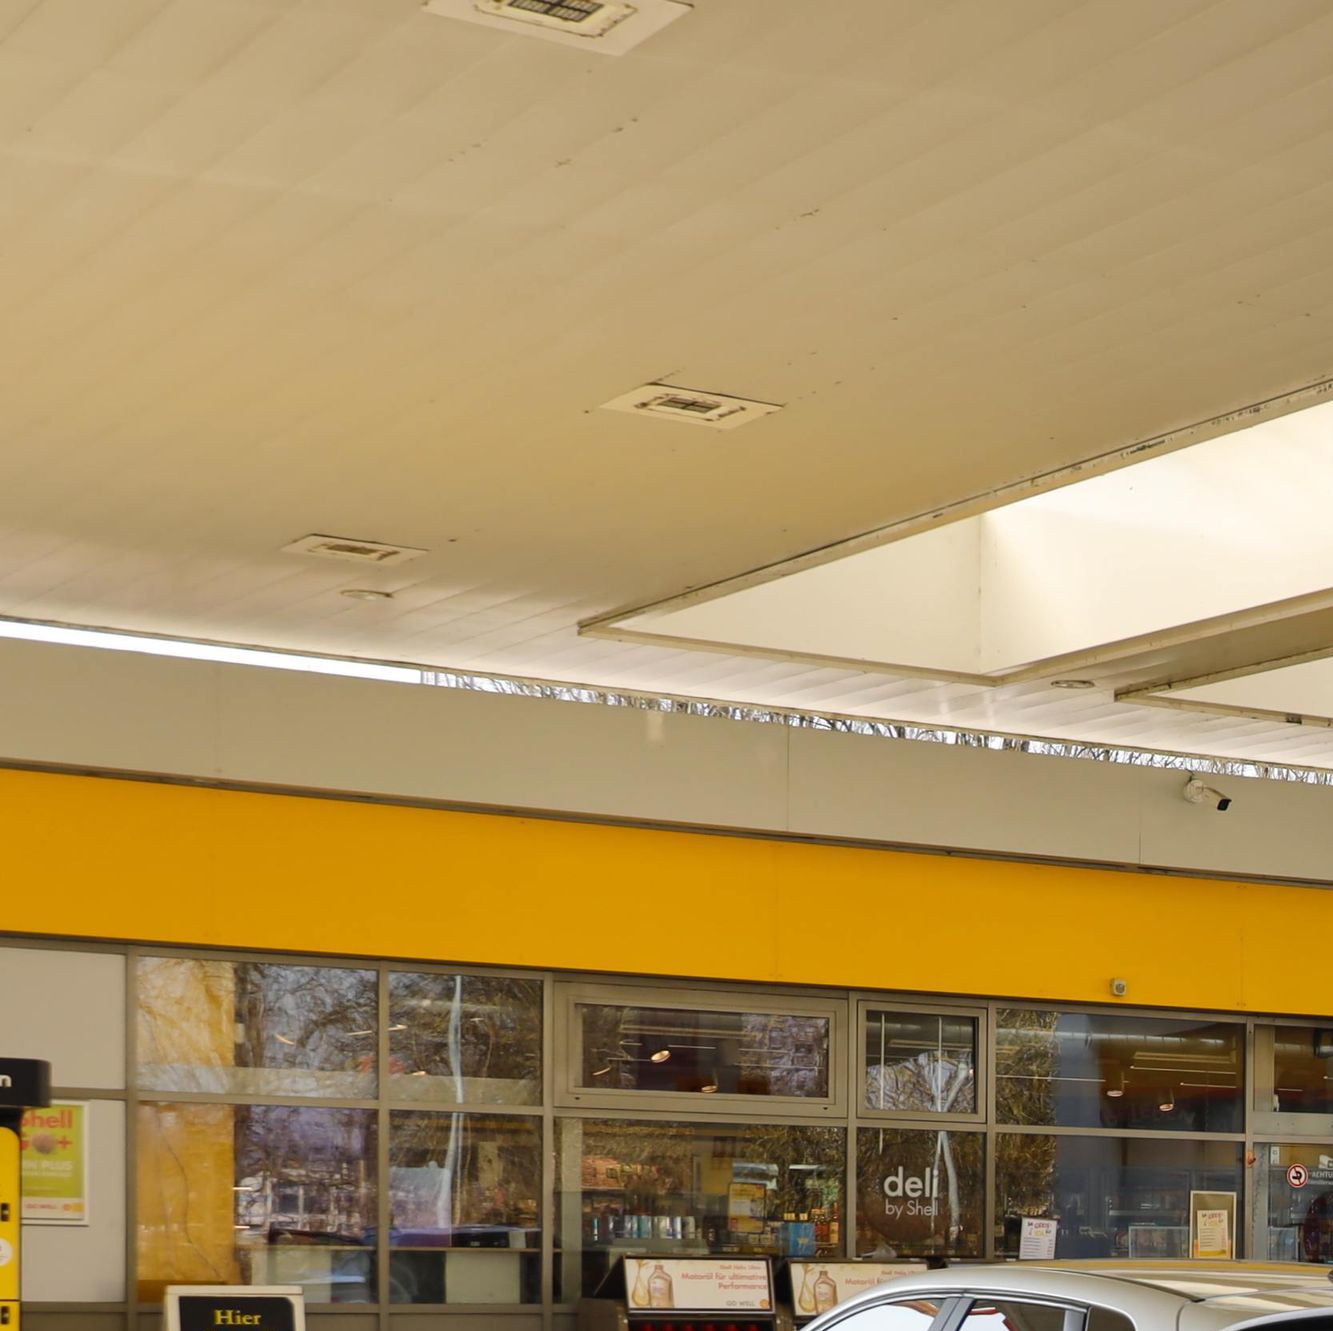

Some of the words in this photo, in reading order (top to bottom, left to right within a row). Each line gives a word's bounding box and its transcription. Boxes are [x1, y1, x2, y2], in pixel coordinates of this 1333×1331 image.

[884, 1166, 939, 1198] deli
[885, 1198, 904, 1220] by
[906, 1199, 939, 1216] Shell
[214, 1309, 261, 1325] Hier
